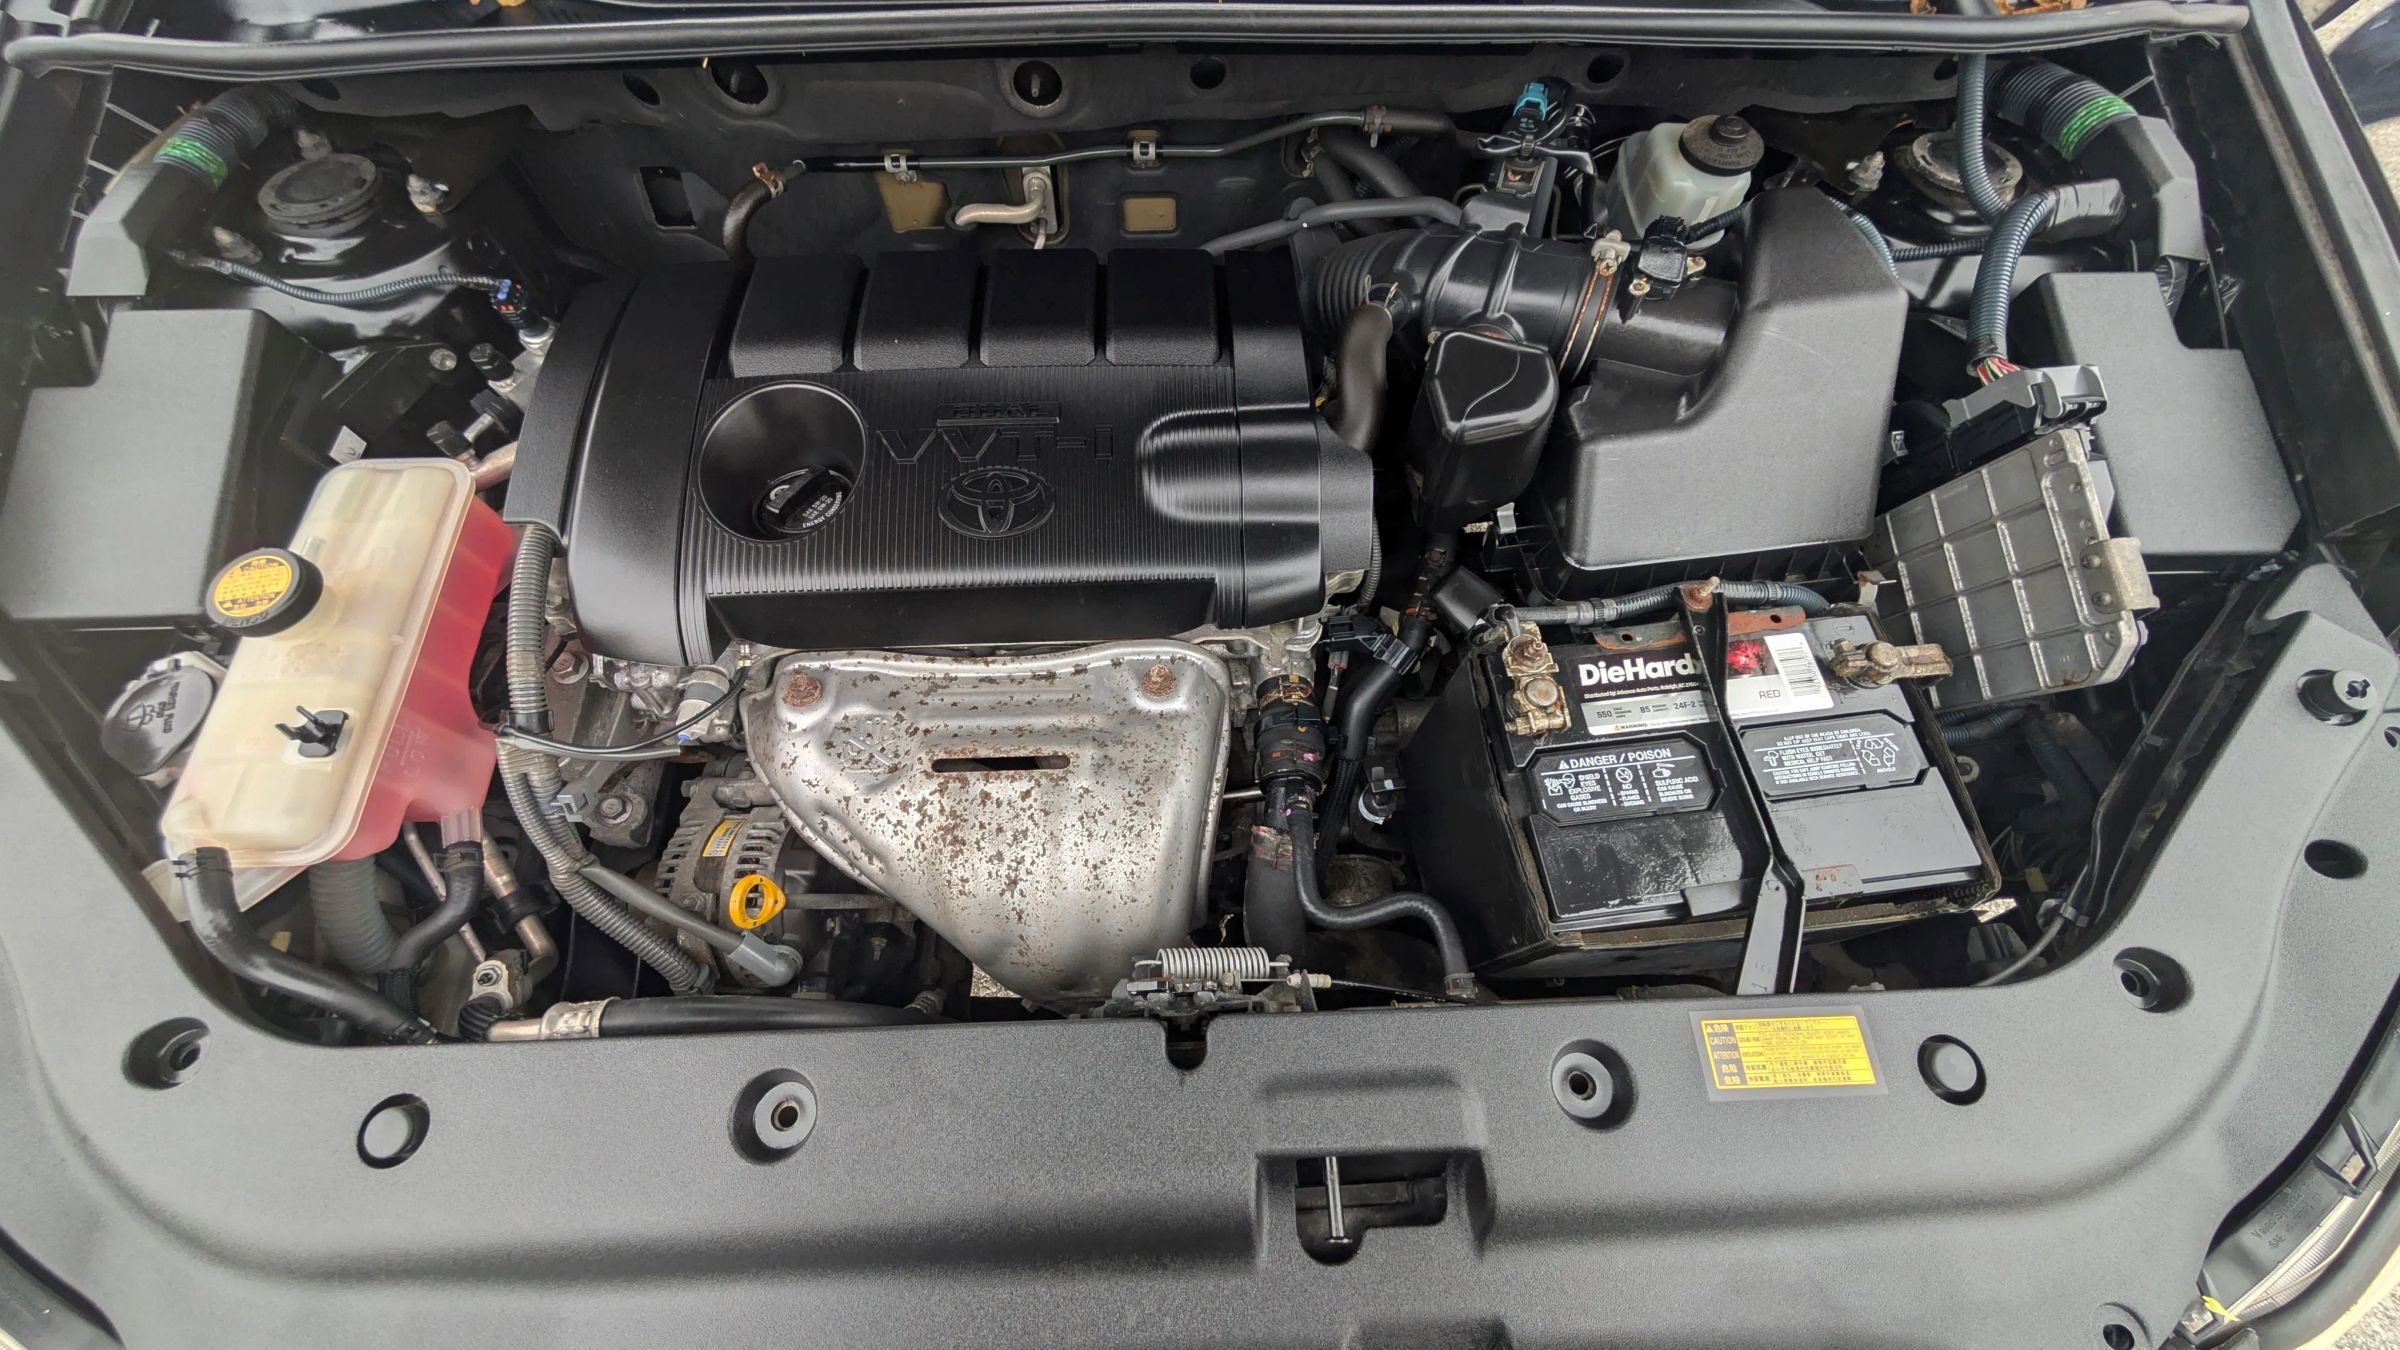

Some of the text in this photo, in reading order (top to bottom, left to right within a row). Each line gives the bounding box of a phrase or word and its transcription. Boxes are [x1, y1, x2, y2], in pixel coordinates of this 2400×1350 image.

[802, 515, 826, 529] ENERGY
[1578, 652, 1696, 687] DieHard
[1584, 691, 1610, 699] Distributed
[1759, 689, 1781, 699] RED
[1596, 710, 1613, 719] 550
[1570, 755, 1617, 769] DANGER
[1628, 748, 1672, 762] POISON
[1578, 772, 1601, 781] SHIELD
[1580, 780, 1597, 788] EYES
[1654, 777, 1684, 786] SULFURIC
[1568, 785, 1602, 795] EXPLOSIVE
[1569, 793, 1592, 801] GASES
[1710, 1036, 1737, 1045] CAUTION
[1713, 1051, 1740, 1059] ATTENTION
